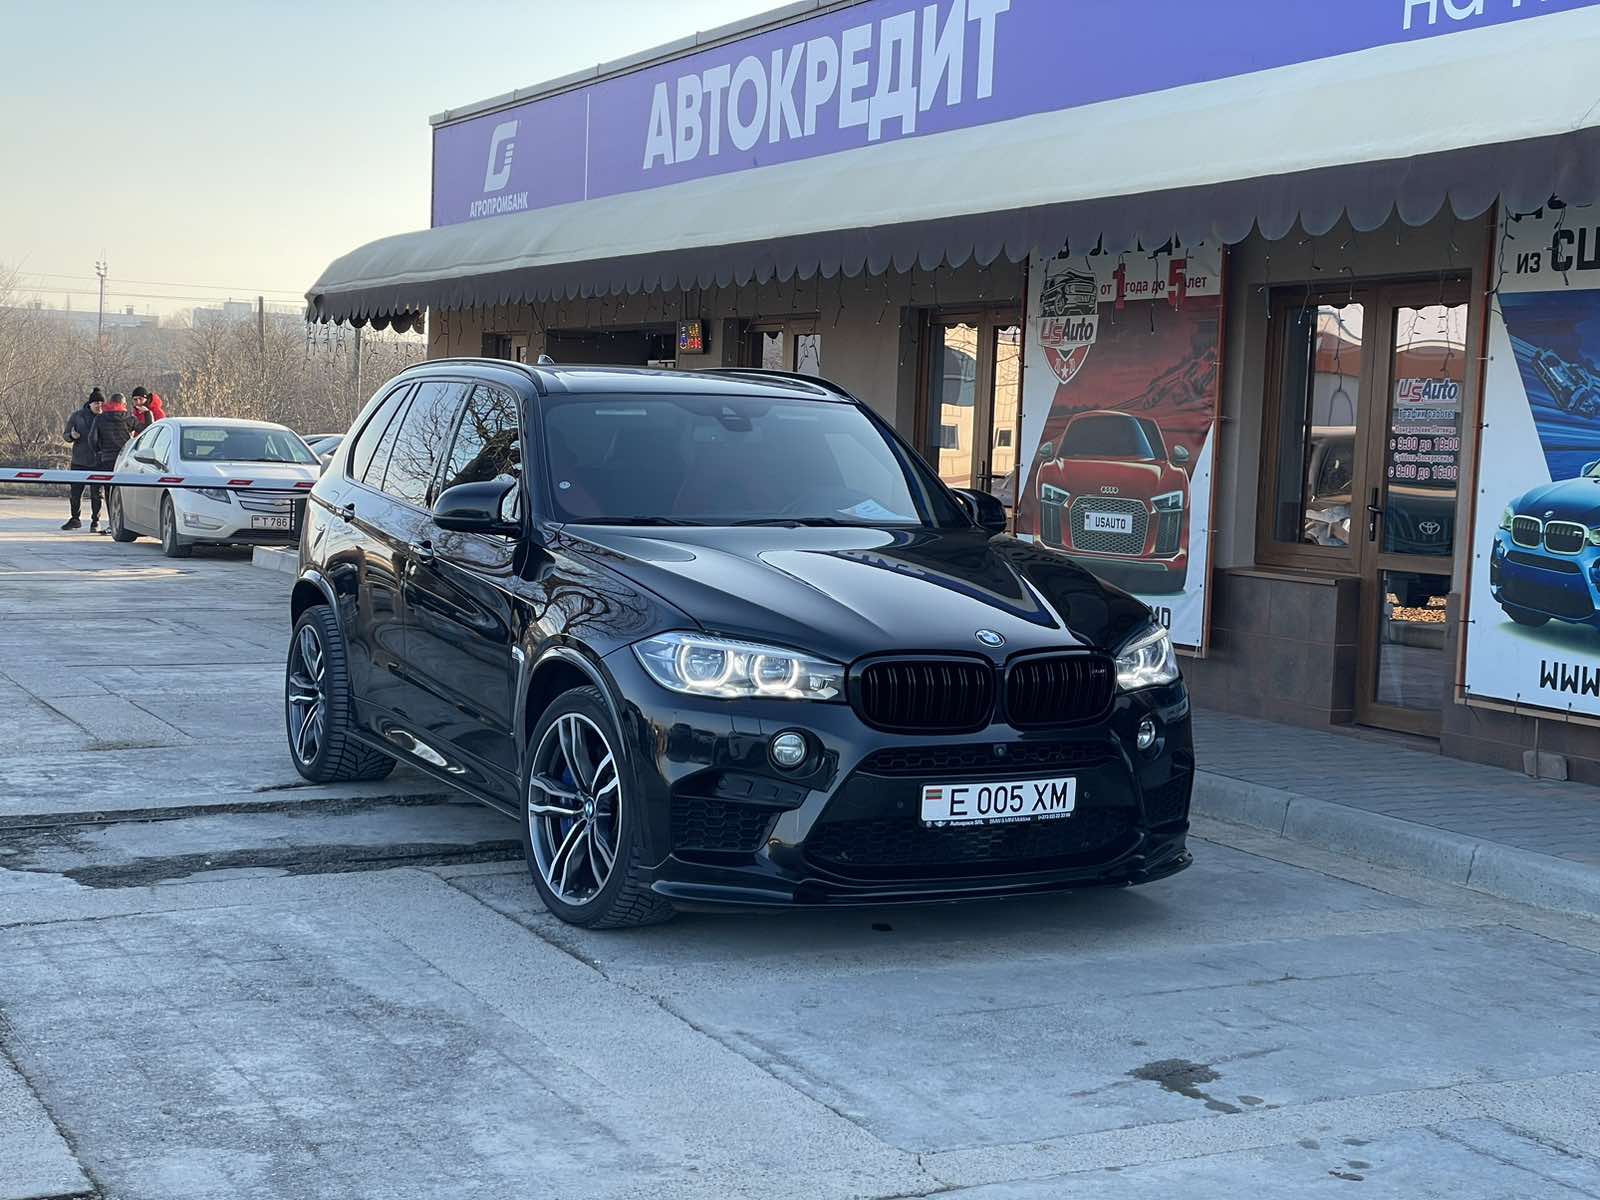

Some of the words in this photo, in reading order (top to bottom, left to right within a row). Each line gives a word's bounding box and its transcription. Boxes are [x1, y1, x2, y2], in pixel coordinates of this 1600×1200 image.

[642, 0, 1010, 169] АВТОКРЕДИТ
[470, 192, 528, 217] АГРОПРОМБАНК
[1101, 284, 1112, 296] от
[1113, 263, 1126, 309] 1
[1124, 280, 1148, 296] года
[1168, 259, 1187, 304] 5
[1185, 276, 1207, 289] лет
[1397, 437, 1418, 450] 9:00
[1419, 440, 1432, 452] до
[1434, 437, 1460, 451] 19:00
[1396, 464, 1417, 478] 9:00
[1418, 467, 1430, 480] до
[1432, 465, 1458, 479] 16:00
[270, 517, 288, 527] 786
[1095, 516, 1126, 530] USAUTO
[950, 788, 969, 816] E
[977, 785, 1024, 815] 005
[1032, 782, 1068, 812] XM
